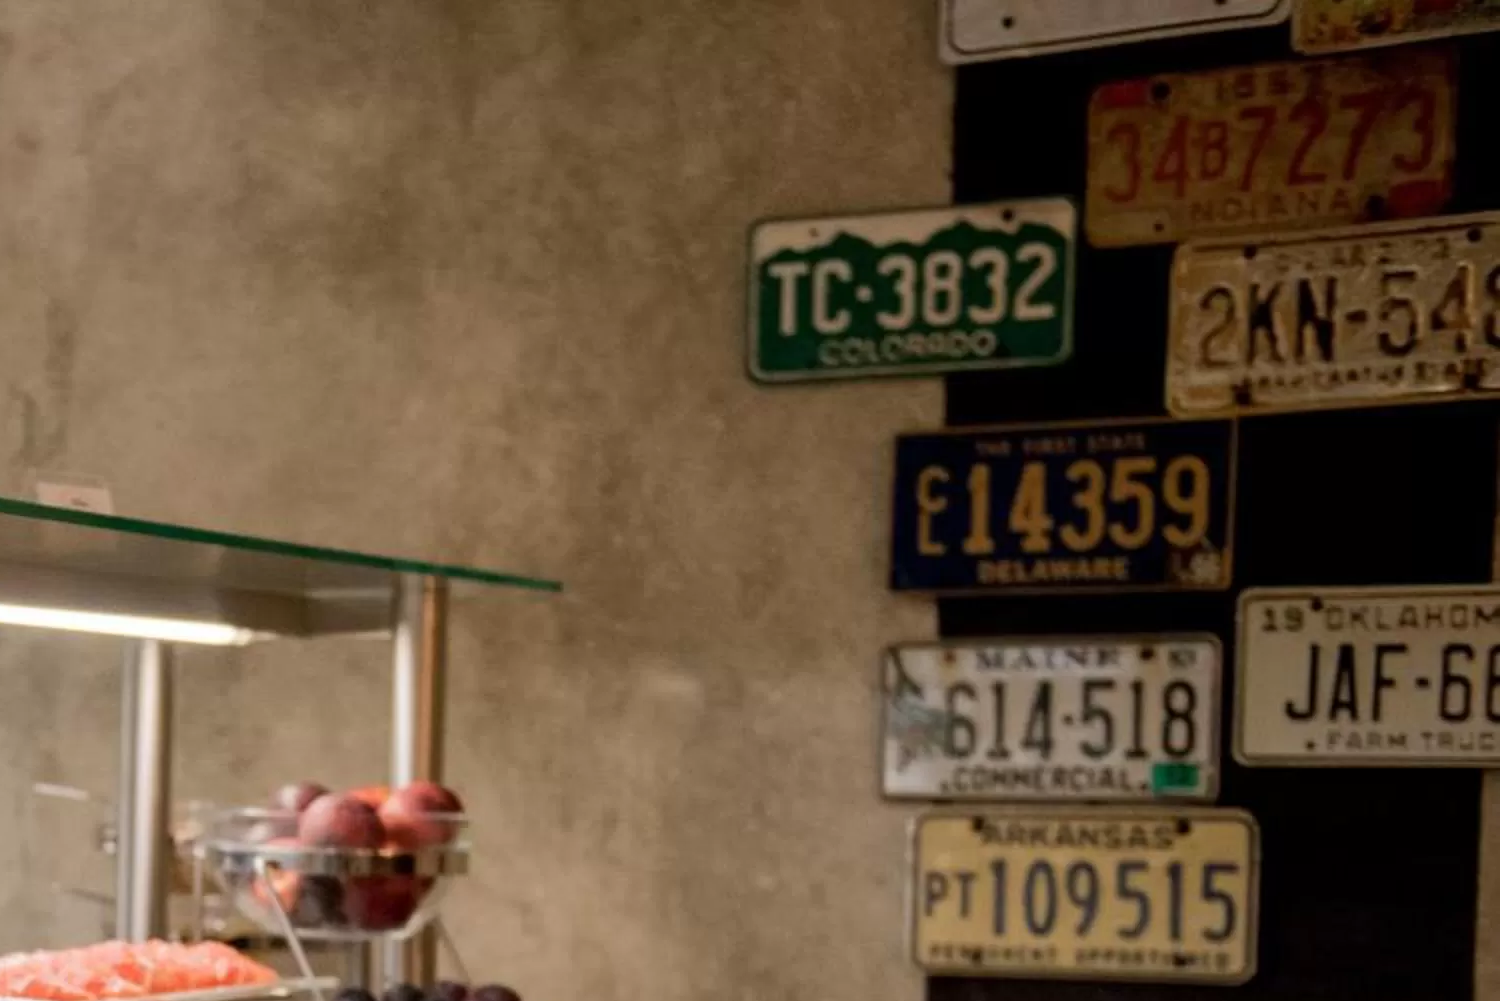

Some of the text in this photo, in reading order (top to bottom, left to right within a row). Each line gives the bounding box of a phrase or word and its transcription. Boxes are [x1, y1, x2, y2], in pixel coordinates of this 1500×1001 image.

[1186, 186, 1353, 222] NDIANA
[817, 327, 998, 366] COLORADO
[960, 453, 1212, 557] 14359
[975, 556, 1132, 584] DELAWARE
[975, 646, 1120, 670] MAINE
[1326, 730, 1408, 750] FARM
[953, 764, 1132, 793] COMMERCIAL
[981, 821, 1174, 849] ARKANSAS
[924, 857, 1240, 943] PT 109515
